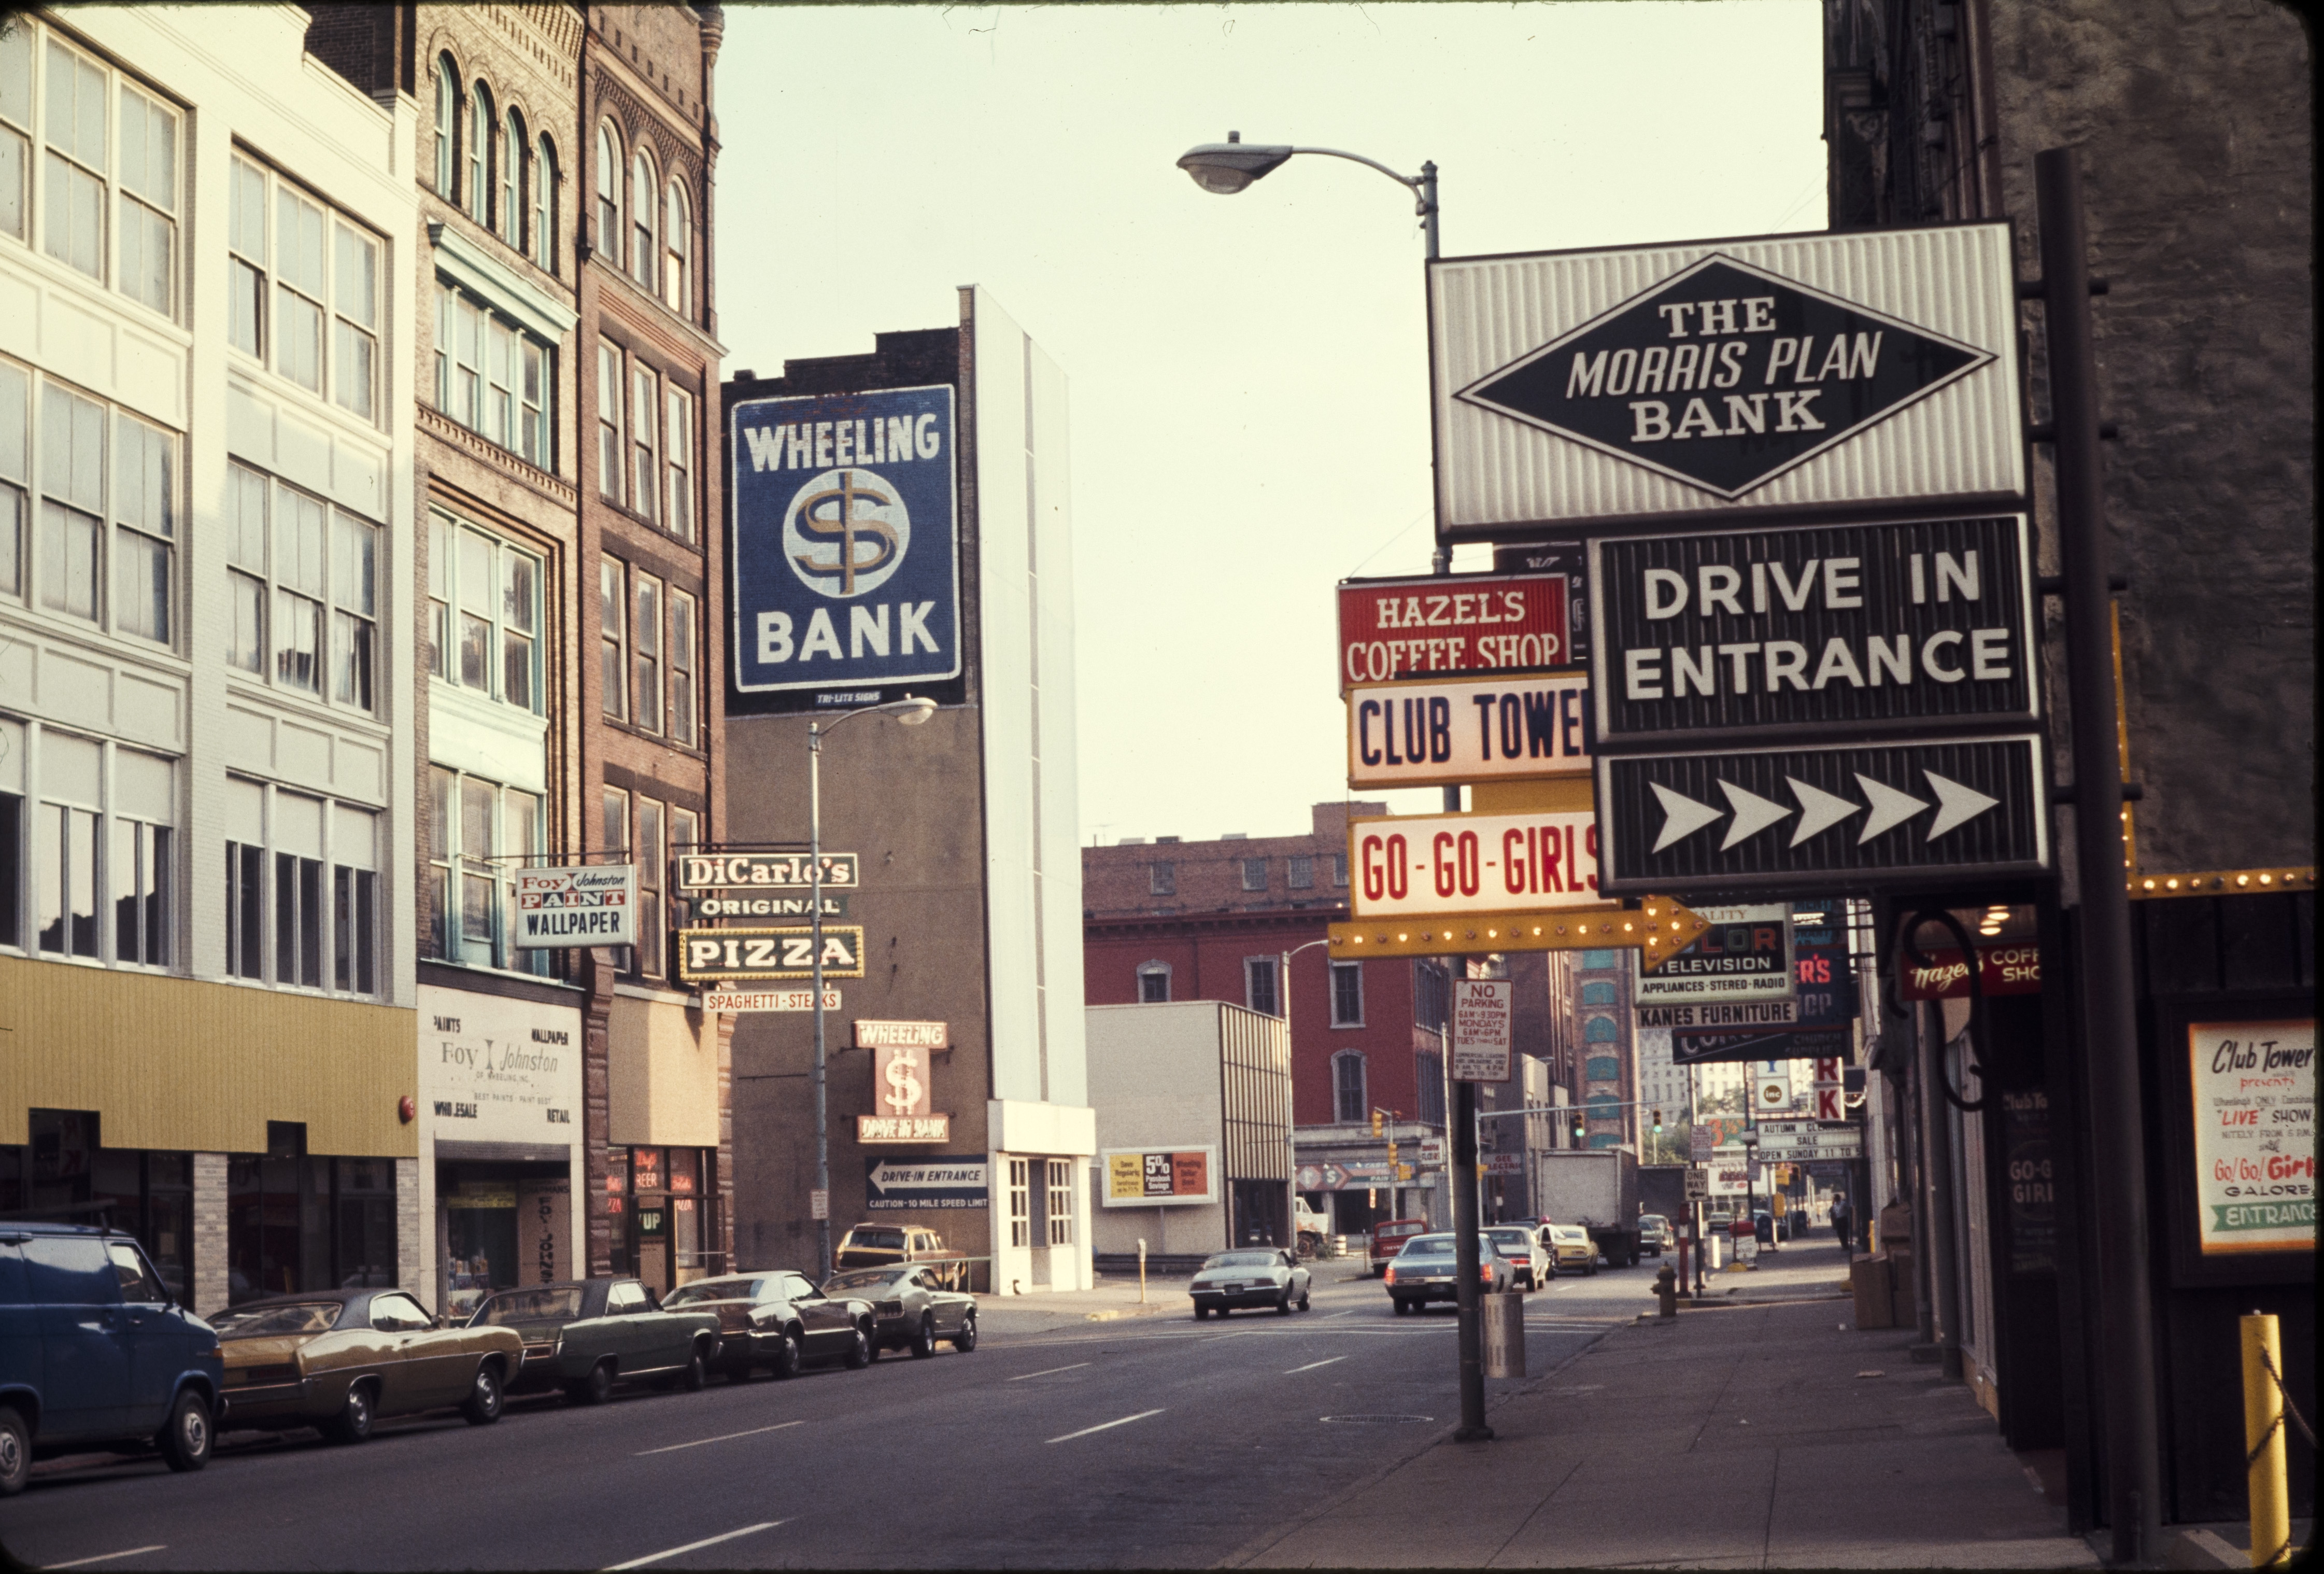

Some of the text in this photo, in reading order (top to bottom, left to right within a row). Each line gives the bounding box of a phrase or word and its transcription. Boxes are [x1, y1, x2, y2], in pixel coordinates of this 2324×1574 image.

[1659, 297, 1776, 338] THE
[1566, 331, 1883, 398] MORRIS PLAN
[1629, 389, 1825, 442] BANK
[744, 413, 940, 472] WHEELING
[1644, 557, 1862, 620] DRIVE
[1910, 550, 1980, 605] IN
[1377, 591, 1525, 628] HAZEL'S
[757, 601, 940, 664] BANK
[1477, 633, 1559, 668] SHOP
[1625, 628, 2011, 700] ENTRANCE
[855, 692, 881, 702] SIGNS
[1359, 688, 1589, 766] CLUB TOWE
[688, 858, 850, 884] DiCarlo's
[521, 873, 625, 890] Foy Johnston
[522, 890, 625, 909] PAINT
[701, 899, 840, 915] ORIGINAL
[527, 911, 620, 936] WALLPAPER
[1697, 909, 1747, 921] ALITY
[690, 938, 855, 968] PIZZA
[1471, 985, 1495, 998] NO
[1642, 978, 1785, 994] APPLIANCES STEREO RADIO
[708, 995, 778, 1009] SPAGHETTI
[789, 993, 836, 1008] STEKS
[1462, 999, 1504, 1009] PARKING
[1640, 1003, 1791, 1027] KANES FURNITURE
[434, 1016, 461, 1033] PAINTS
[1459, 1020, 1505, 1029] MONDAYS
[860, 1024, 943, 1045] WHEELING
[442, 1042, 558, 1072] Foy Johnston
[2212, 1039, 2314, 1074] Club Tower
[1765, 1090, 1780, 1098] inc
[2240, 1077, 2295, 1094] presents
[434, 1101, 477, 1118] WHOESALE
[2255, 1096, 2276, 1106] ONLY
[547, 1108, 570, 1123] RETAIL
[2272, 1109, 2311, 1123] SHOW
[913, 1119, 945, 1138] BANK
[1764, 1124, 1796, 1133] AUTUMN
[2222, 1130, 2254, 1139] NITELY
[2260, 1129, 2284, 1138] FROM
[1797, 1136, 1818, 1145] SALE
[1760, 1151, 1781, 1160] OPEN
[1787, 1149, 1819, 1159] SUNDAY
[1841, 1148, 1851, 1157] TO
[1145, 1155, 1170, 1174] 5%
[882, 1170, 981, 1182] DRIVE-IN ENTRANCE
[1326, 1170, 1336, 1184] S
[1687, 1181, 1705, 1189] WAY
[919, 1199, 940, 1207] MILE
[941, 1199, 966, 1207] SPEED
[968, 1198, 987, 1207] LIMIT
[639, 1213, 661, 1230] UP
